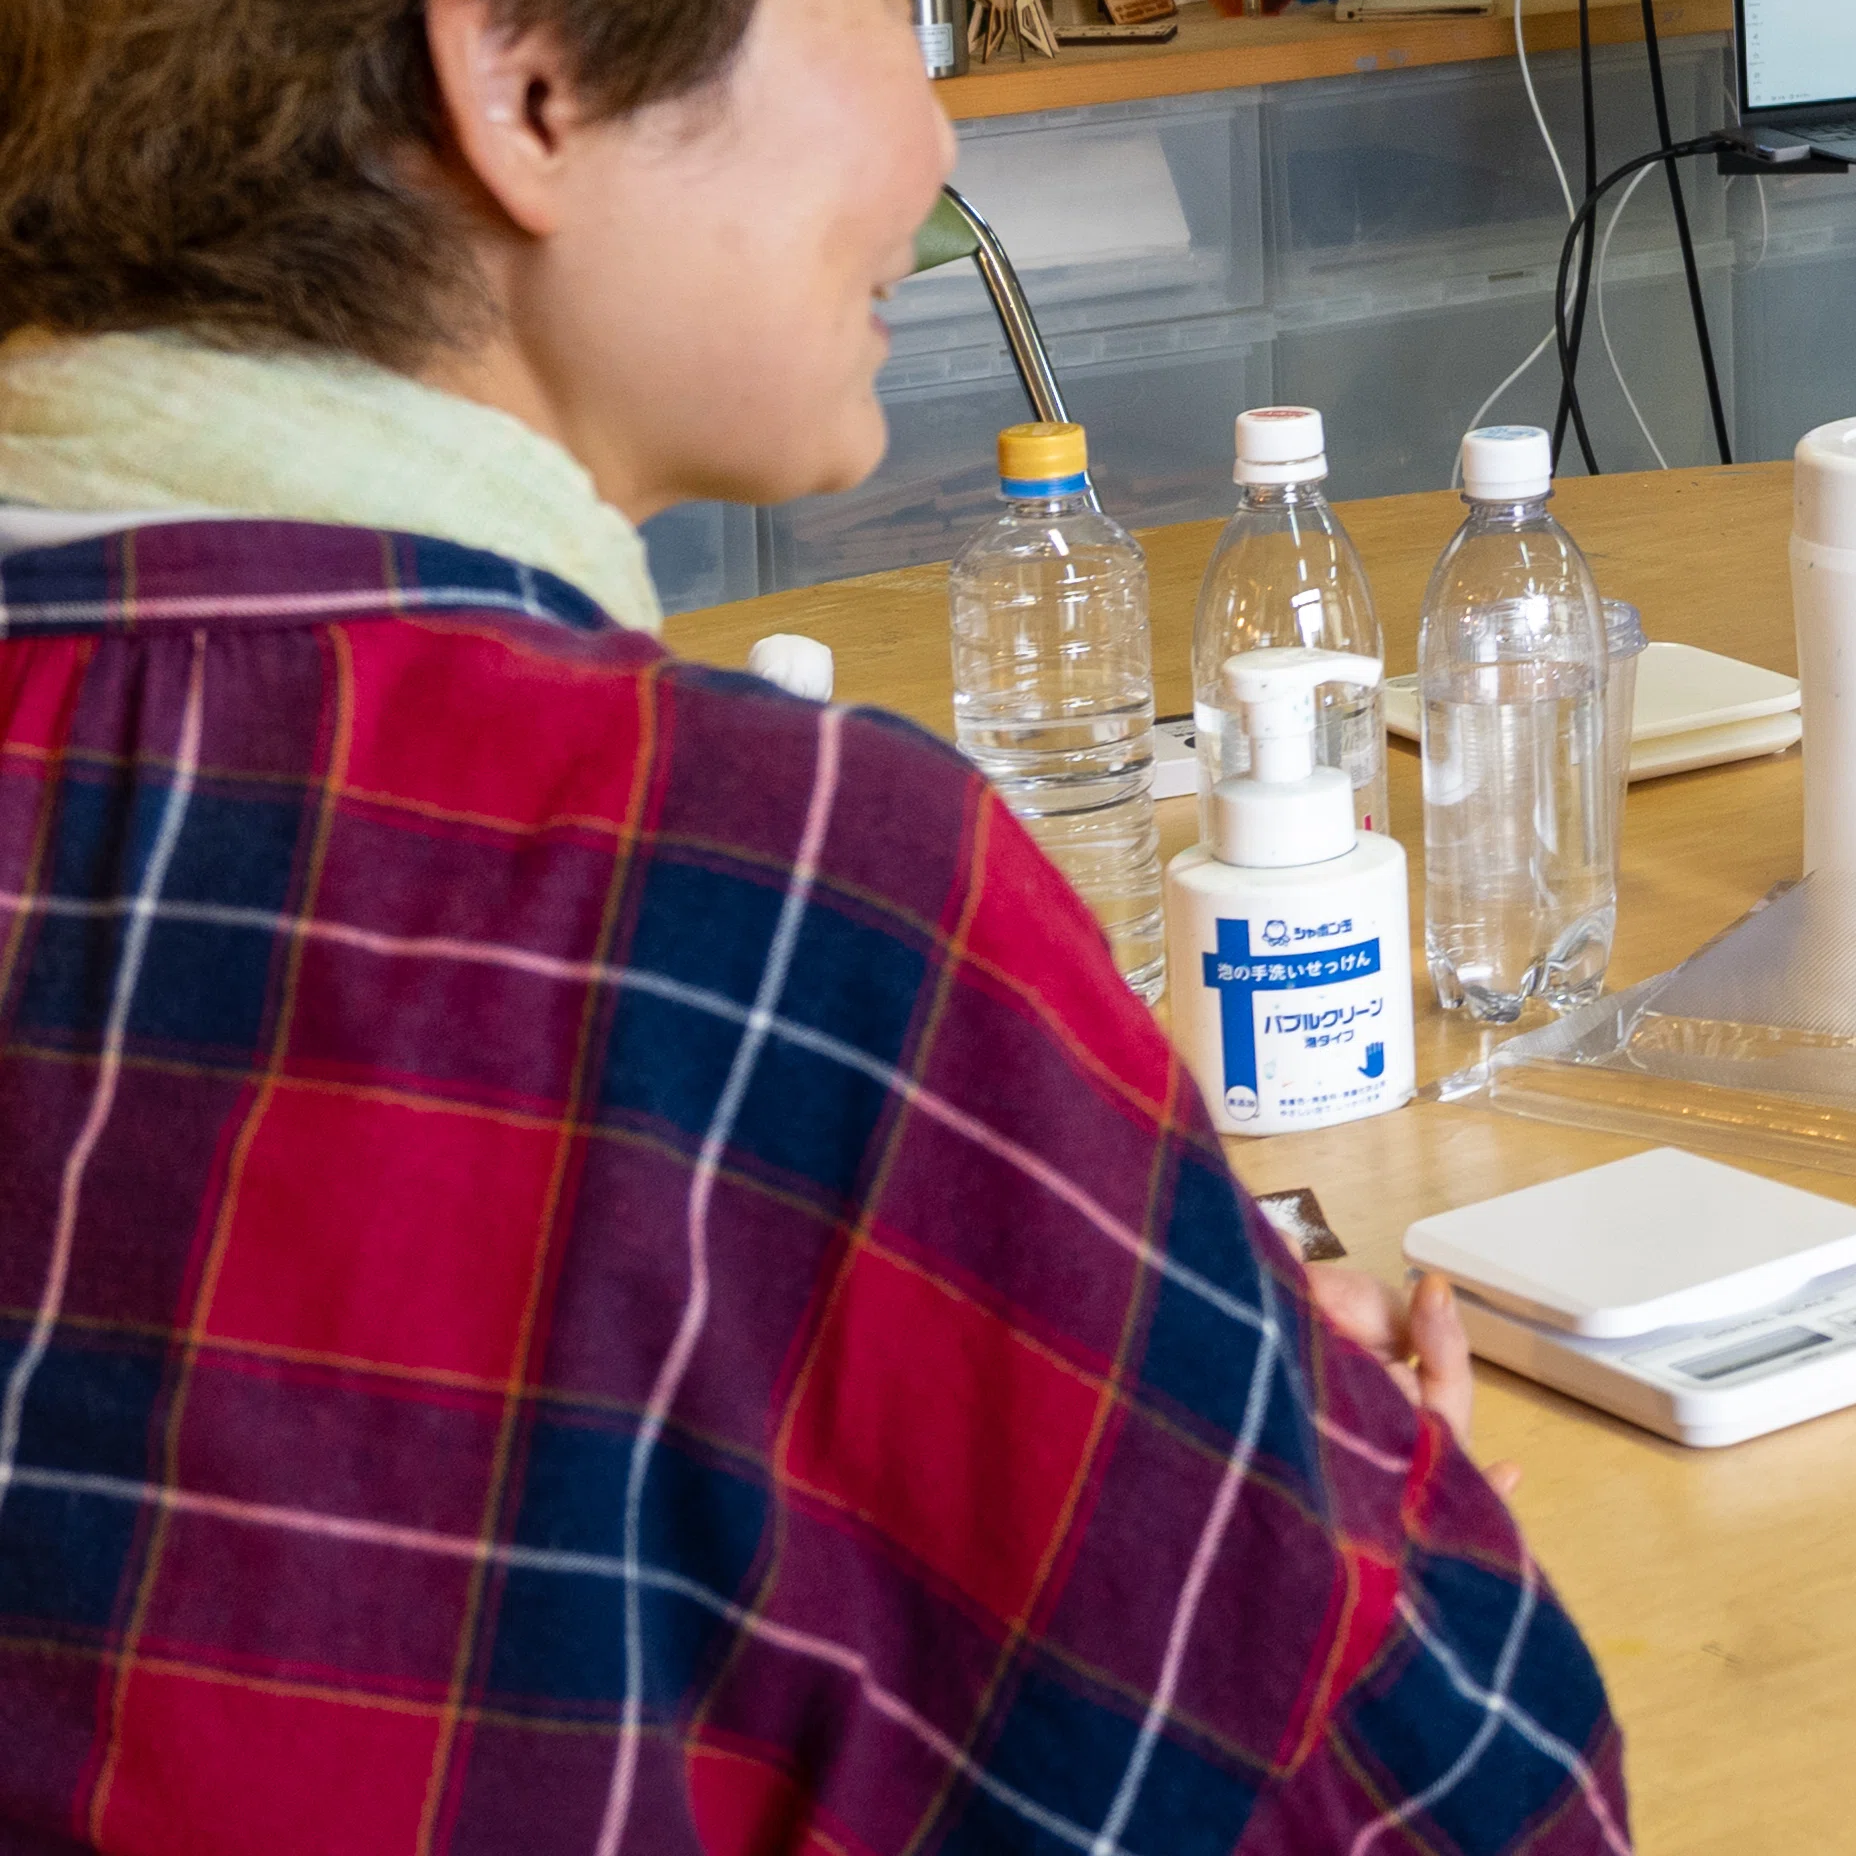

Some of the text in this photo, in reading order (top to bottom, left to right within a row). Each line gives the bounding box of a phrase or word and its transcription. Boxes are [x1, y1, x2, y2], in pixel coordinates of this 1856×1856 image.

[1293, 918, 1353, 941] シャボン玉
[1217, 950, 1372, 982] 泡の手洗いせっけん
[1304, 1029, 1355, 1049] 泡タイプ
